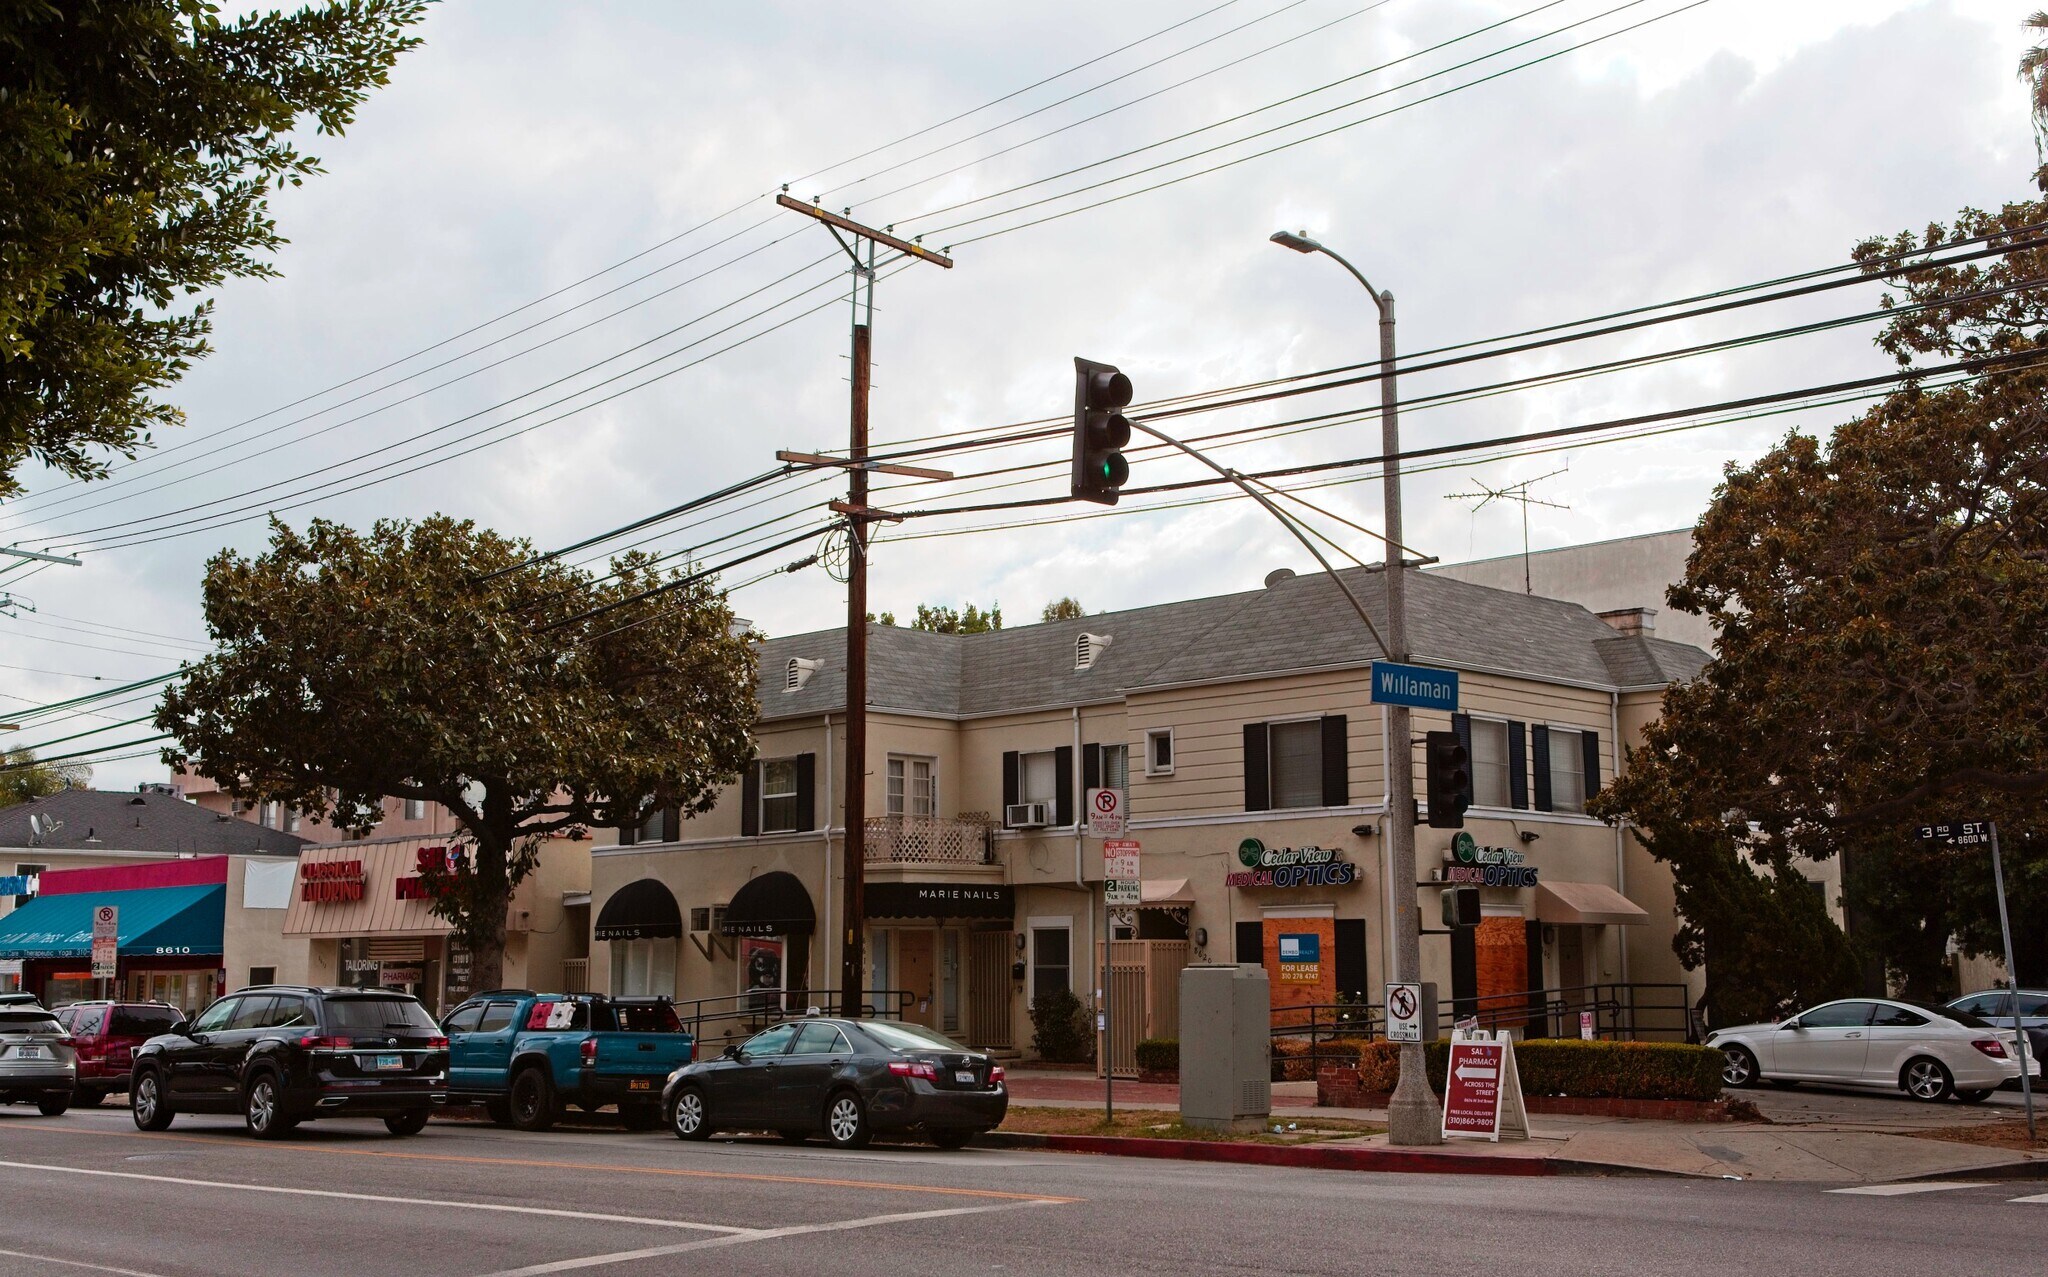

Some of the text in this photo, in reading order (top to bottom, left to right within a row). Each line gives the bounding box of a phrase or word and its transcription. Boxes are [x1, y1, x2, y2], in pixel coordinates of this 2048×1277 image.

[1381, 671, 1451, 700] Willaman
[1921, 822, 1985, 838] 3 RD ST.
[1957, 834, 1979, 844] 8600
[1105, 847, 1139, 858] NO STOPPING
[1260, 845, 1333, 867] Cedar View
[1475, 846, 1525, 865] Cedar View
[300, 860, 364, 880] CLASSICAL
[1225, 862, 1352, 888] MEDICAL OPTICS
[1447, 864, 1539, 888] MEDICAL OPTICS
[300, 880, 364, 902] TAILORING
[1107, 880, 1115, 891] 2
[1117, 884, 1139, 892] PARKING
[919, 889, 1000, 900] MARIE NAILS
[608, 929, 641, 938] NAILS
[738, 924, 773, 933] NAILS
[156, 946, 191, 955] 8610
[344, 959, 379, 971] TAILORING
[1281, 964, 1319, 972] FOR LEASE
[382, 971, 421, 981] PHARMACY
[1281, 972, 1319, 980] 310 278 4747
[1399, 1022, 1408, 1031] USE
[1390, 1031, 1418, 1039] CROSSWALK
[1471, 1047, 1484, 1056] SAL
[1458, 1057, 1498, 1066] PHARMACY
[1447, 1116, 1494, 1127] (310)860-9809
